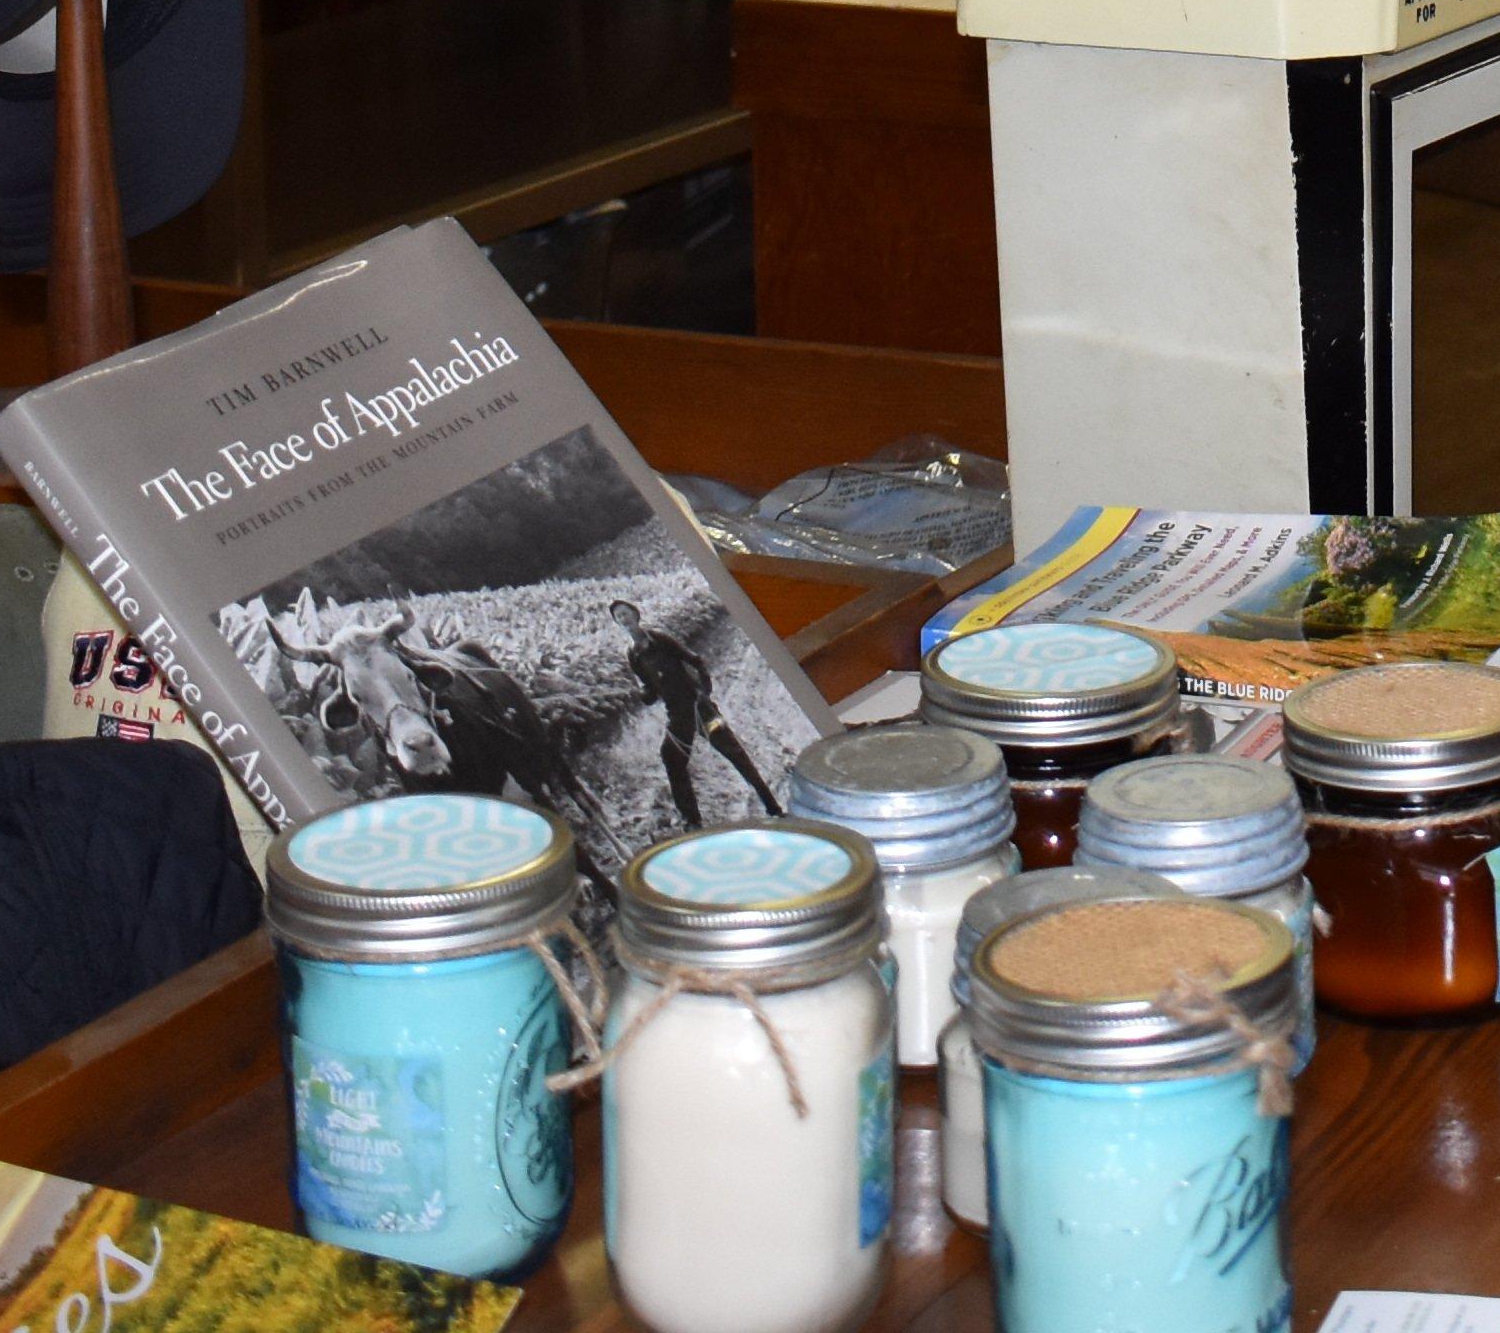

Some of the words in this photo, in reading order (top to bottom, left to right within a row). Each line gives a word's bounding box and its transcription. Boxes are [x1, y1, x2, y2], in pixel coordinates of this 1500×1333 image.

[1416, 3, 1436, 23] FOR
[205, 383, 257, 417] TIM
[262, 326, 389, 393] BARNWELL
[140, 467, 233, 521] The
[218, 440, 313, 490] Face
[312, 397, 352, 451] of
[344, 331, 519, 437] Appalachia
[214, 497, 306, 546] PORTRAITS
[307, 475, 354, 503] FROM
[357, 454, 390, 478] THE
[392, 414, 473, 461] MOUNTAIN
[476, 389, 520, 421] FARM
[1088, 589, 1129, 614] Blue
[1124, 565, 1165, 597] Ridge
[1152, 522, 1213, 573] Parkway
[1092, 542, 1160, 586] Traveling
[1143, 520, 1177, 549] the
[1214, 574, 1256, 599] Leonard
[1261, 526, 1293, 564] Adkins
[24, 461, 79, 538] BARNWELL
[86, 533, 139, 622] The
[140, 613, 202, 707] Face
[201, 710, 248, 750] of
[69, 629, 180, 700] US
[1184, 675, 1214, 697] THE
[1216, 679, 1256, 700] BLUE
[73, 690, 188, 726] ORIGINA
